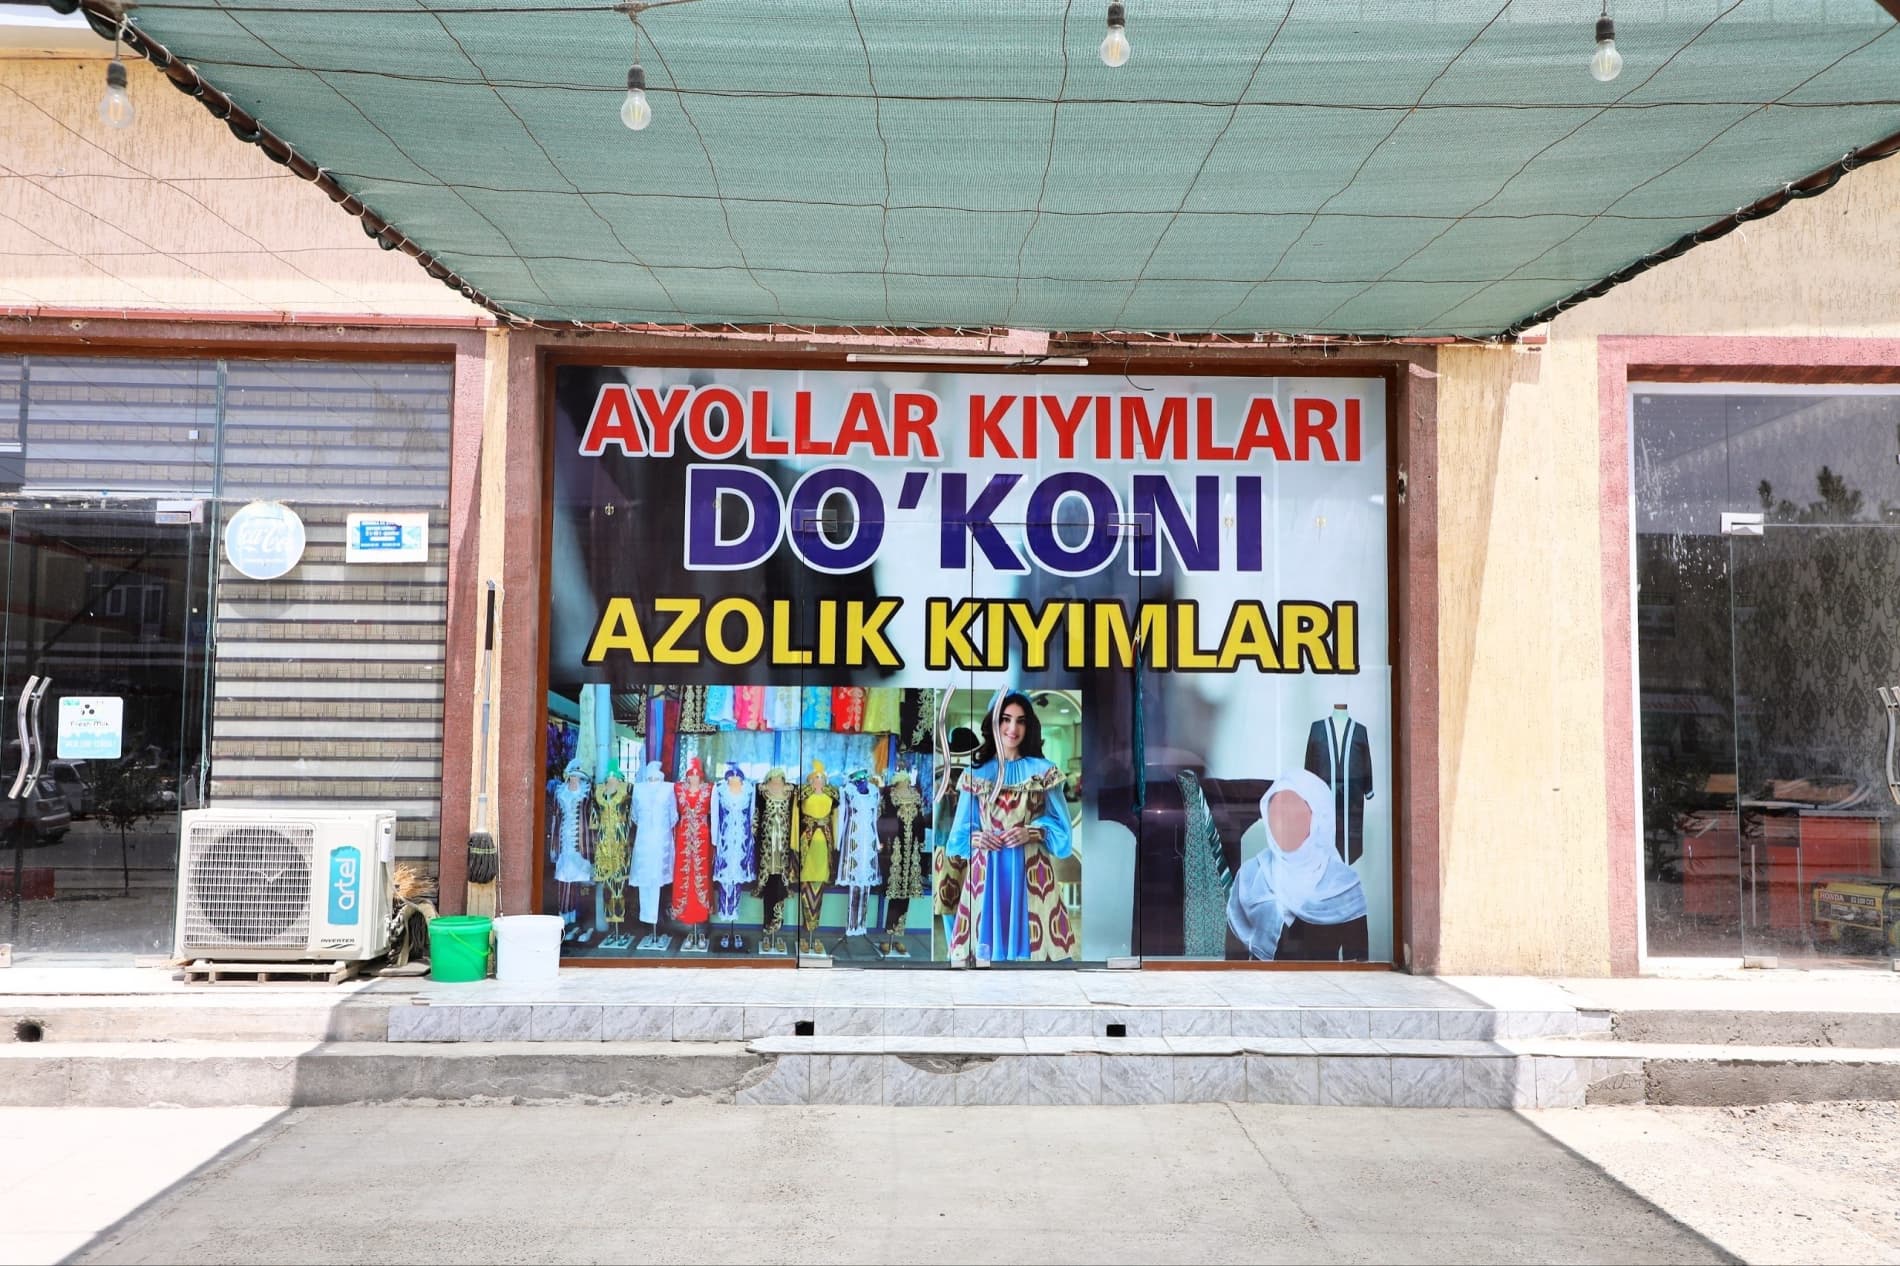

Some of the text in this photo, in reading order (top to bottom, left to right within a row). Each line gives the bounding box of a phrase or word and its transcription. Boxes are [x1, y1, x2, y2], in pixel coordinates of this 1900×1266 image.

[580, 385, 1362, 463] AYOLLAR KIYIMLARI
[584, 596, 1359, 672] AZOLIK KIYIMLARI
[334, 858, 355, 910] artel
[1820, 891, 1845, 902] HONDA
